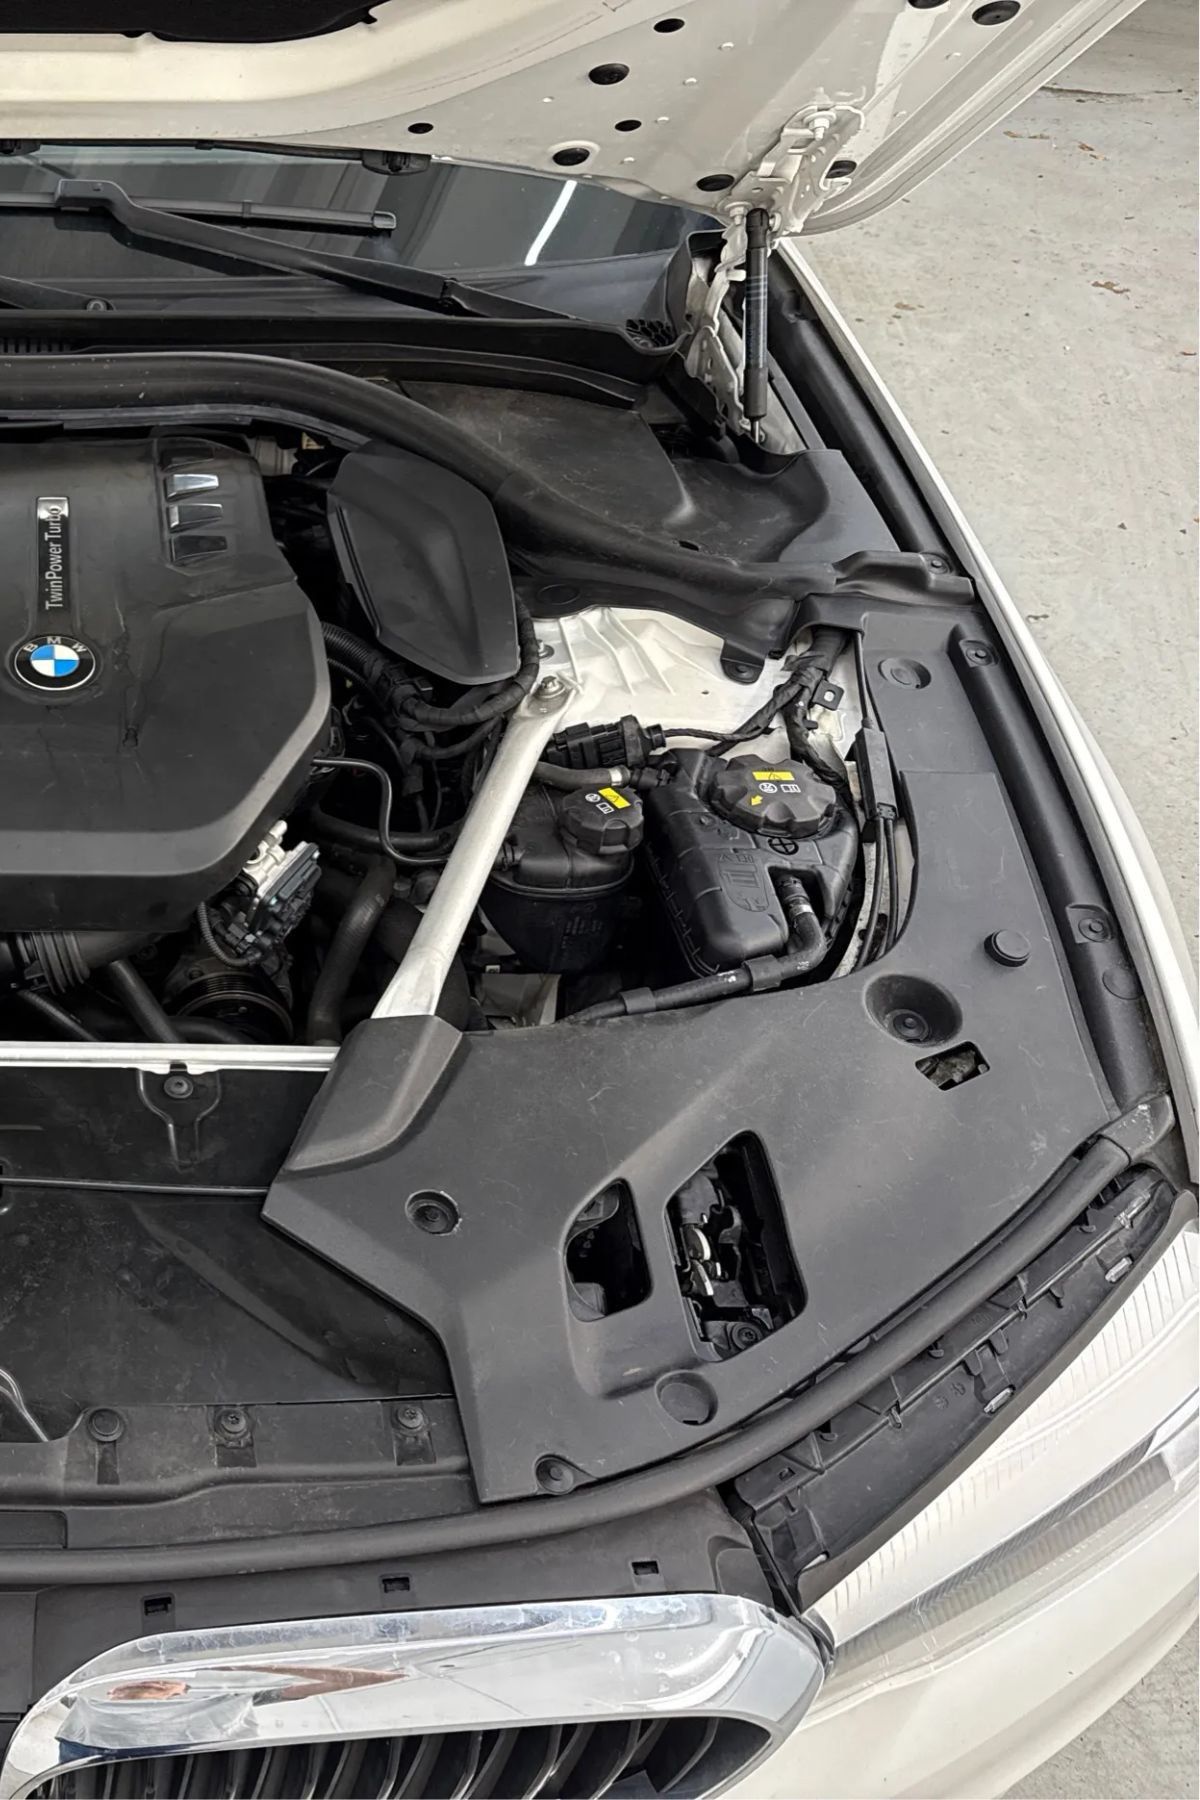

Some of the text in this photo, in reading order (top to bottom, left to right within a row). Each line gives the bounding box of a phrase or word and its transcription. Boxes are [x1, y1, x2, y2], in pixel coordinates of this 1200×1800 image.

[44, 507, 63, 610] TwinPower Turbo
[23, 636, 88, 654] BMW
